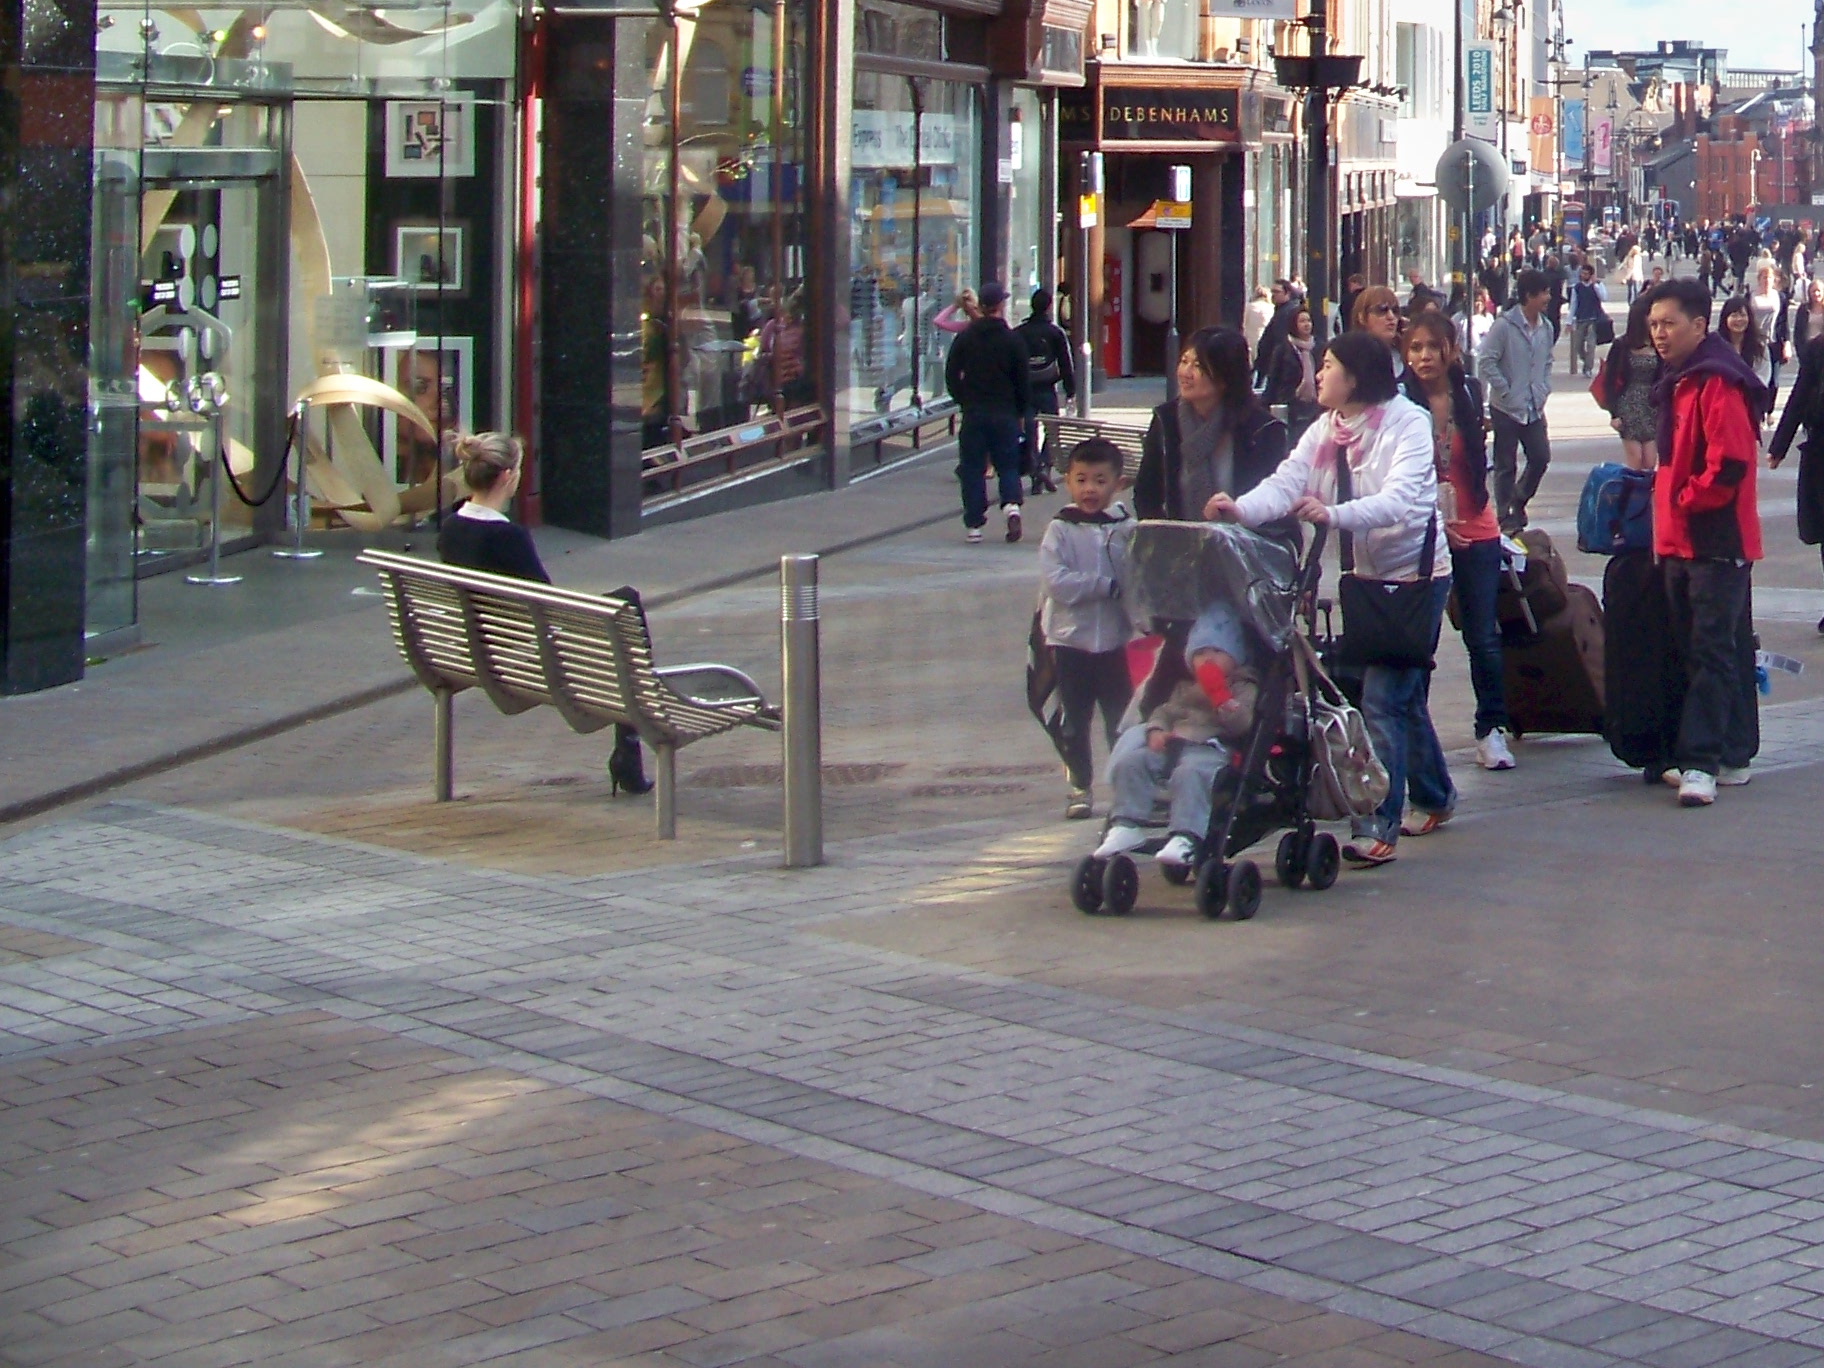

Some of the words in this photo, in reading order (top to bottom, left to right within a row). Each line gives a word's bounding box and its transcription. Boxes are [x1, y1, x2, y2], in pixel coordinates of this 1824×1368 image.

[1472, 51, 1481, 76] 2010
[1472, 80, 1481, 111] LEEDS
[1110, 106, 1229, 123] DEBENHAMS
